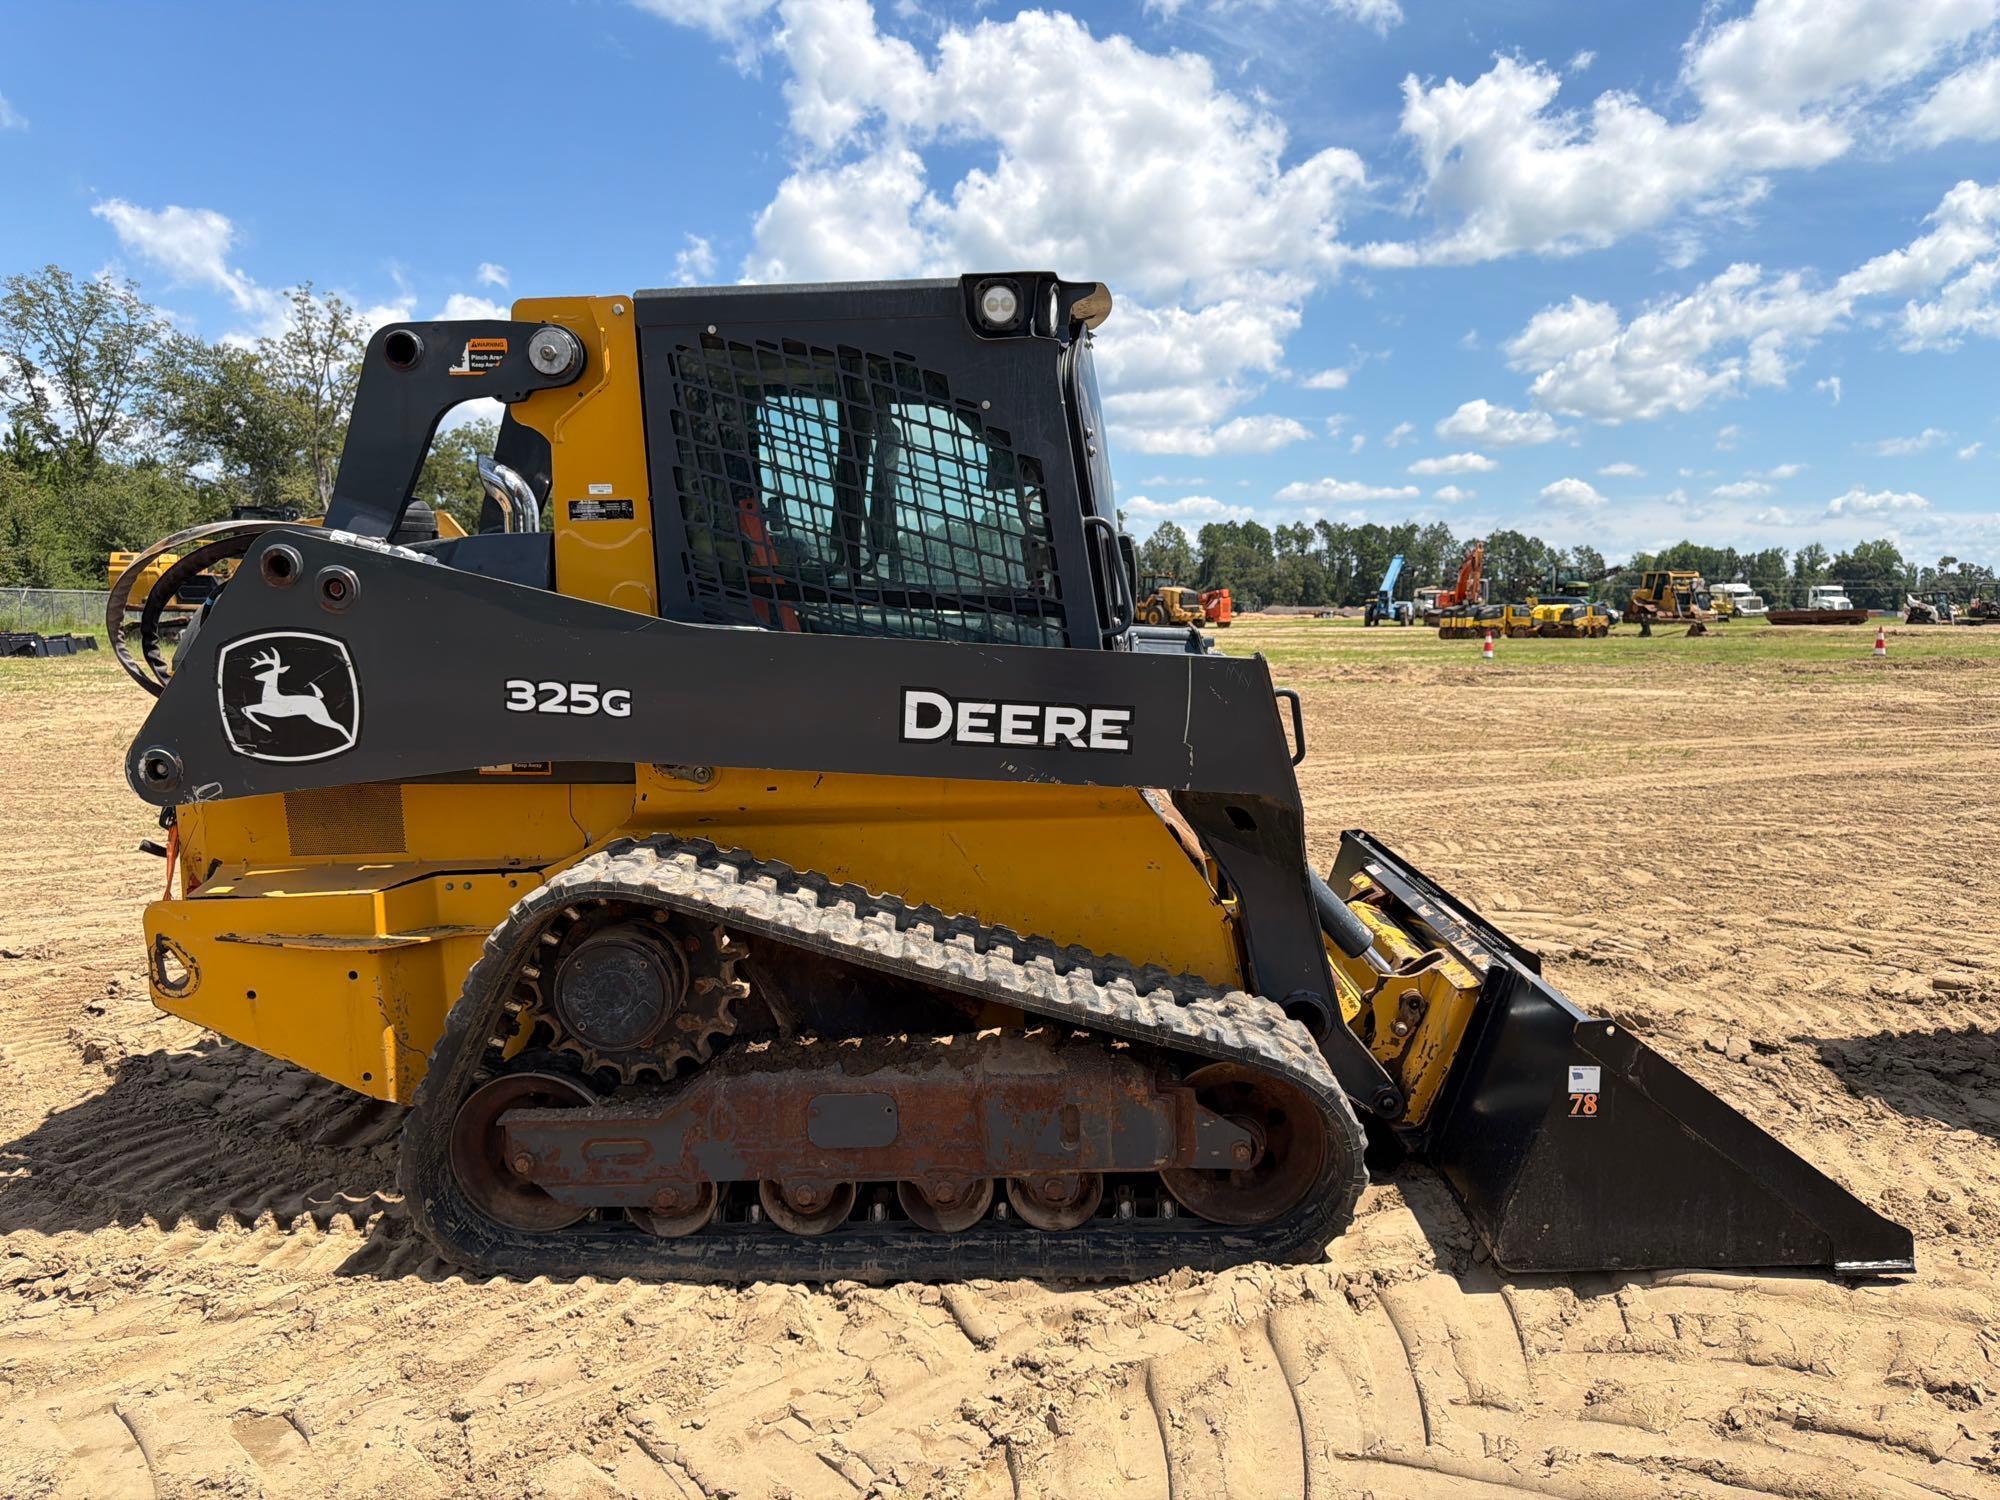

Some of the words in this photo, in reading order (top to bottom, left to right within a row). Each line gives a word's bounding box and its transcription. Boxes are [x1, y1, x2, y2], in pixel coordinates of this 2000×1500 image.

[506, 679, 631, 717] 325G
[904, 690, 1130, 750] DEERE
[1569, 1093, 1597, 1115] 78
